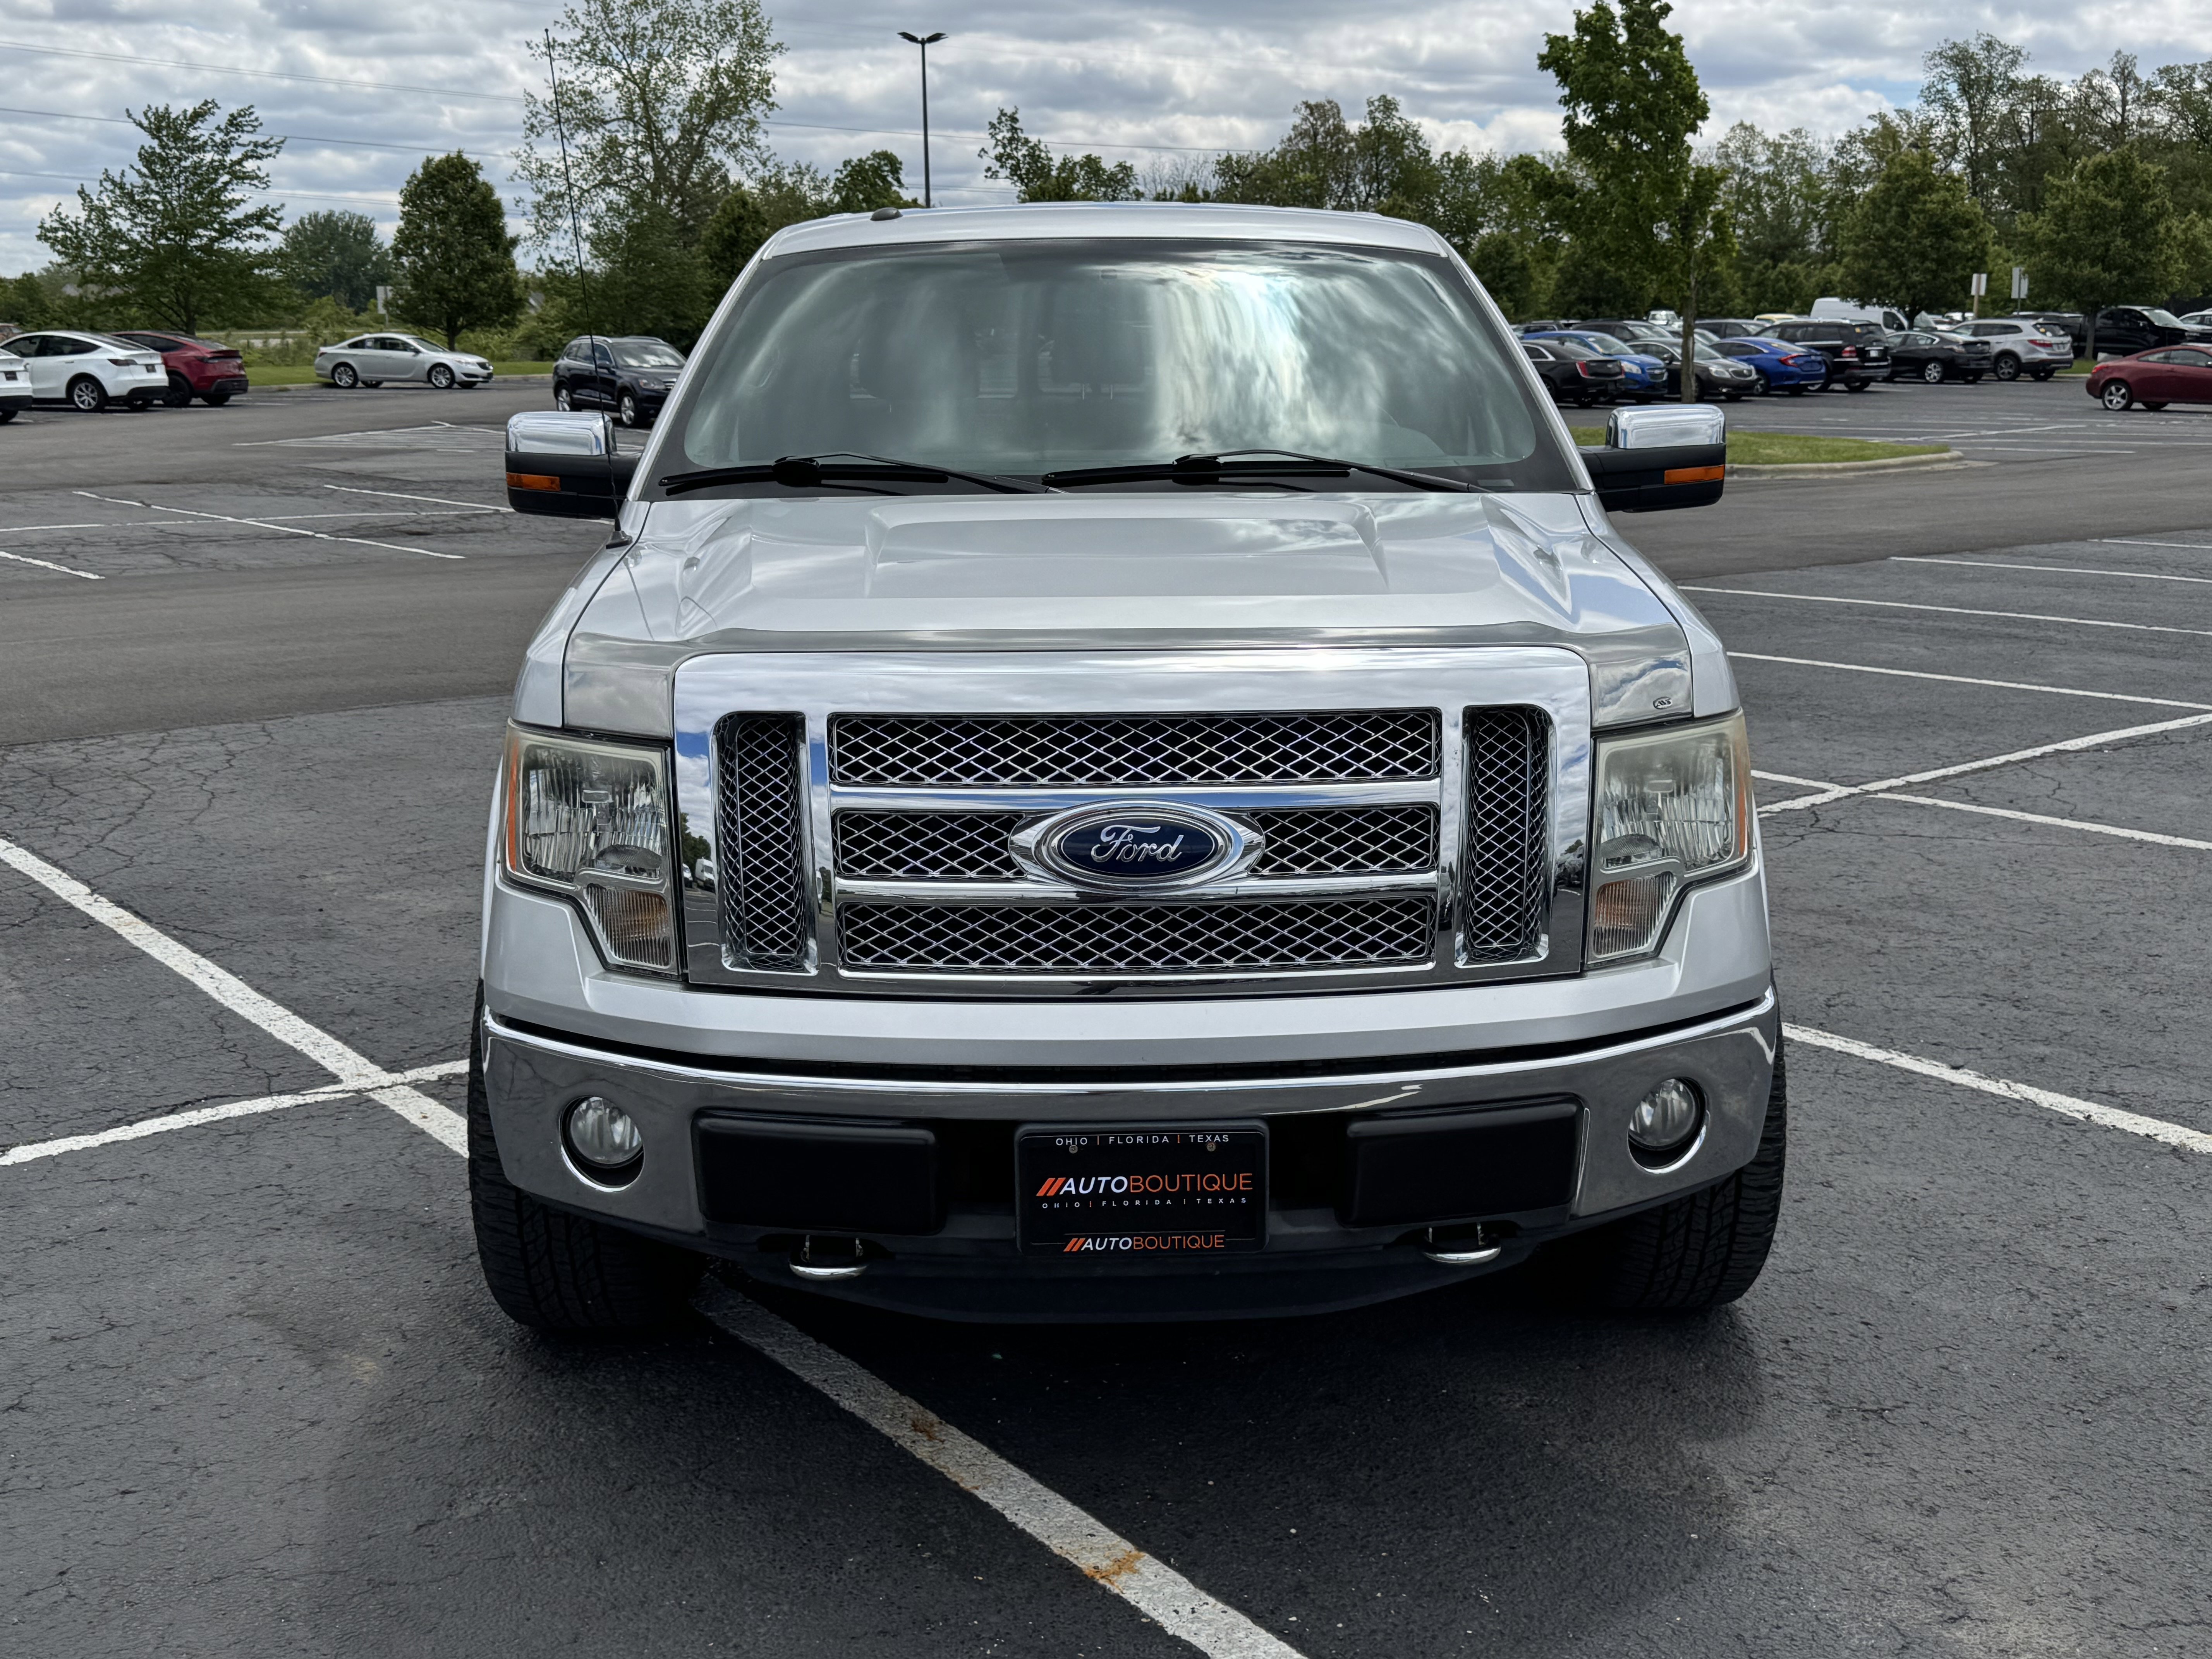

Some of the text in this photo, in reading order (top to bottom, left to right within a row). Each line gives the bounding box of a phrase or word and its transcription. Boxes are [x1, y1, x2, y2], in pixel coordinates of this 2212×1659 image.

[1091, 824, 1184, 863] Ford
[1056, 1137, 1087, 1146] OHIO
[1109, 1136, 1169, 1144] FLORIDA
